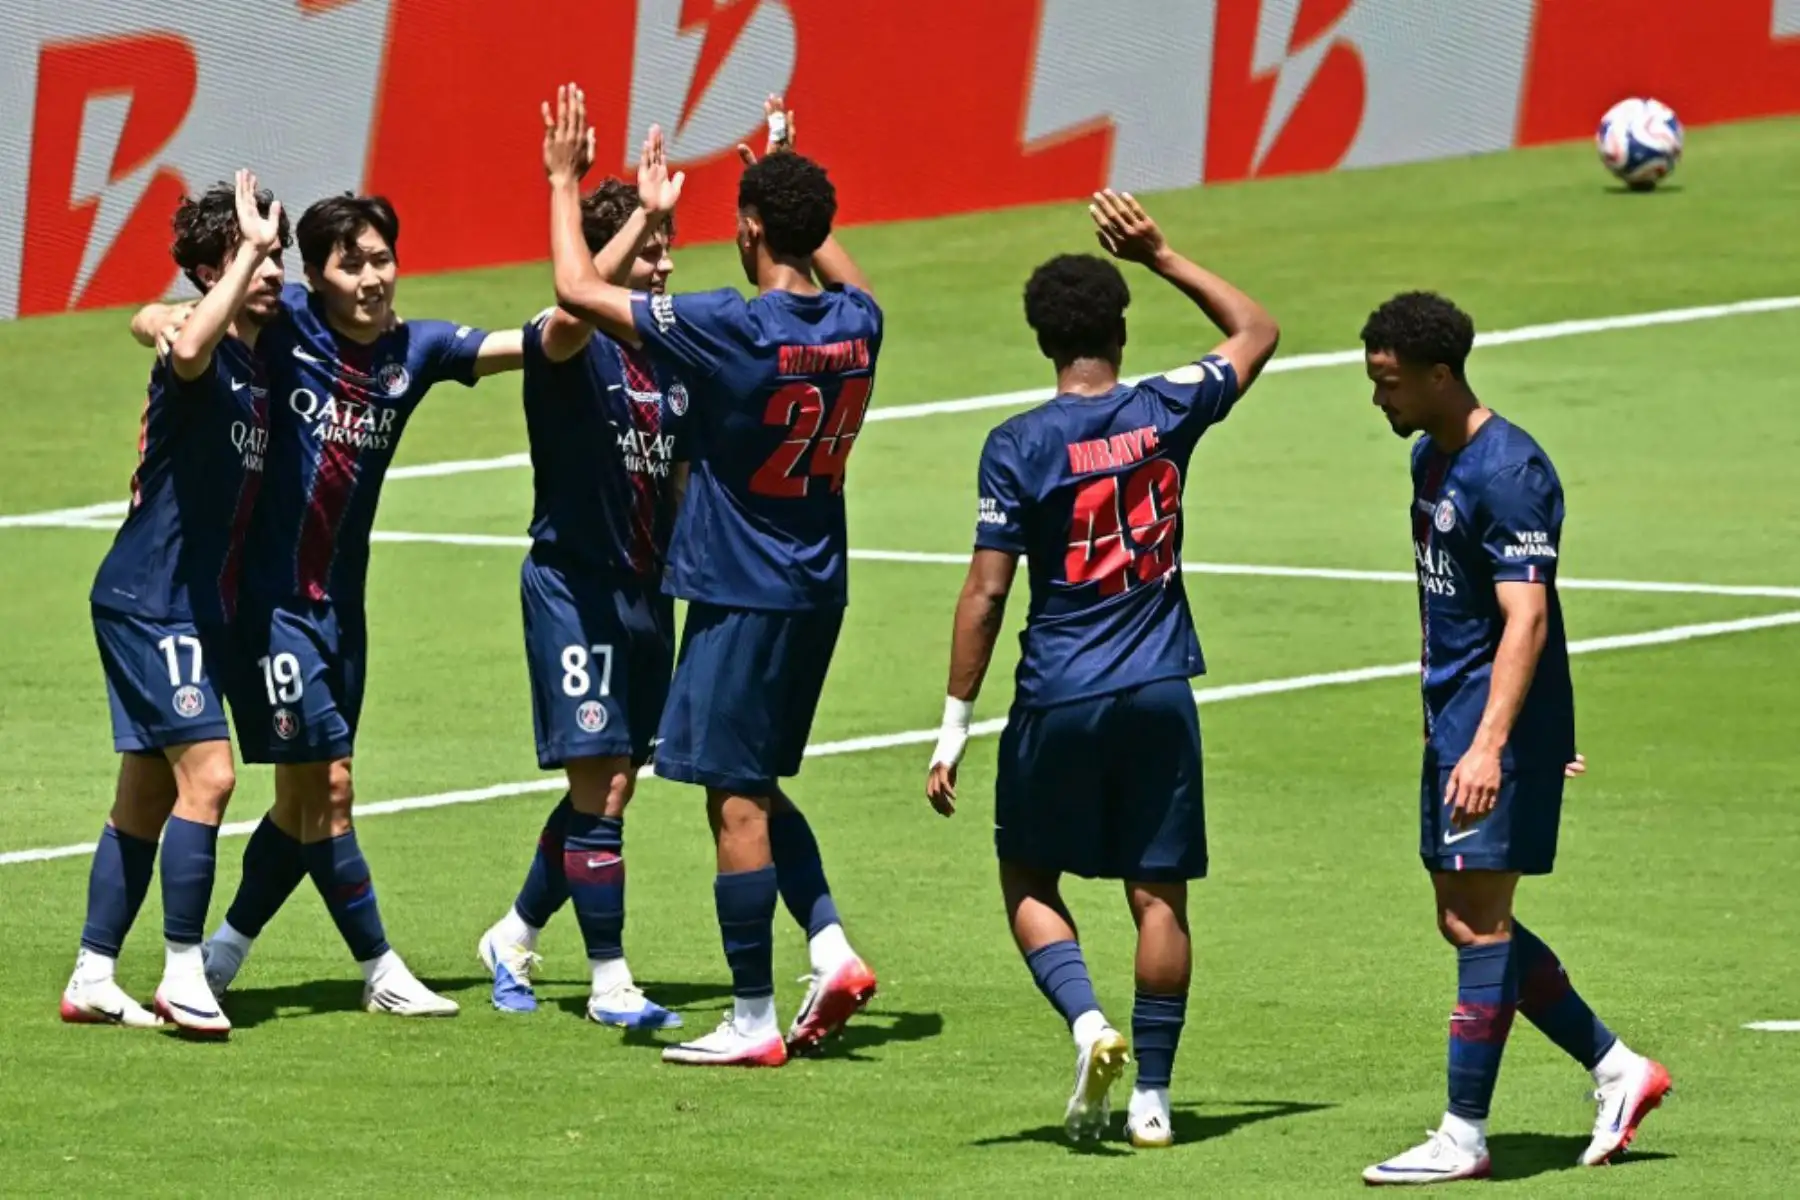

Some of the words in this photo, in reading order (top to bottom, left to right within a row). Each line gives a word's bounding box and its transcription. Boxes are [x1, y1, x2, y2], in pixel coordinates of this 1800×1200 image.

[289, 388, 397, 433] QATAR
[312, 422, 390, 450] AIRWAYS
[610, 420, 676, 460] ATAR
[750, 376, 873, 498] 24
[158, 635, 203, 687] 17
[257, 652, 303, 705] 19
[560, 644, 613, 697] 87
